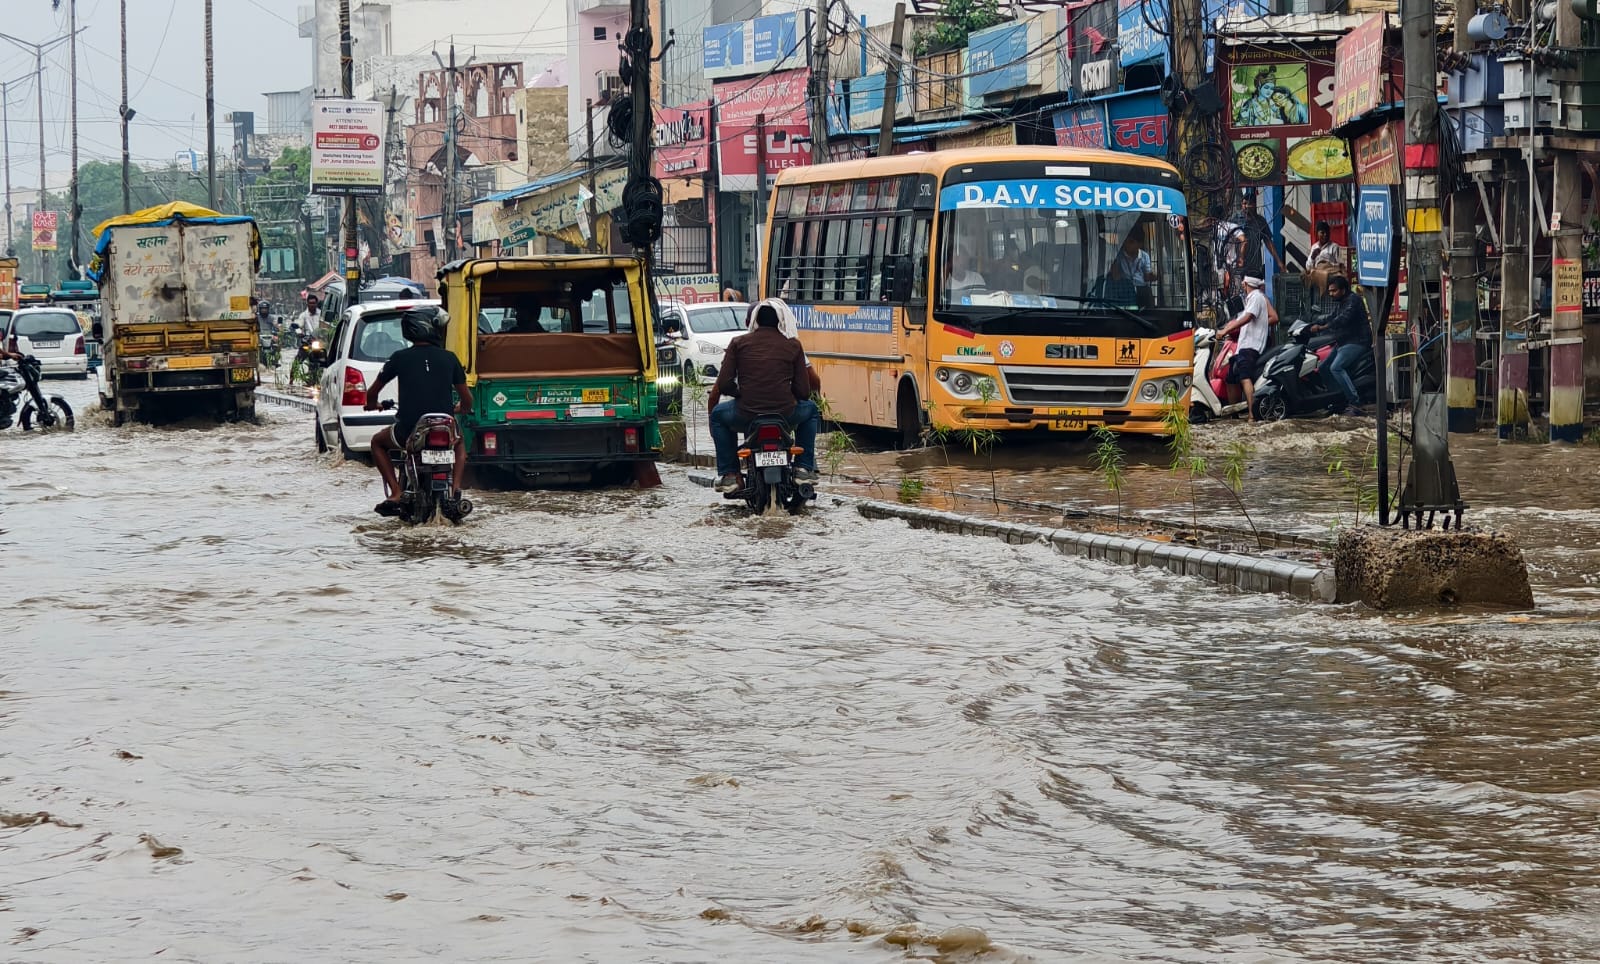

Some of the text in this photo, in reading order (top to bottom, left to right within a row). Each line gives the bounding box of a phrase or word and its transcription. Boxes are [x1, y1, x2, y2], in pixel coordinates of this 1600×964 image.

[766, 160, 796, 169] ILES
[963, 184, 1172, 210] D.A.V. SCHOOL
[957, 346, 978, 356] CNG
[1160, 345, 1176, 355] S7
